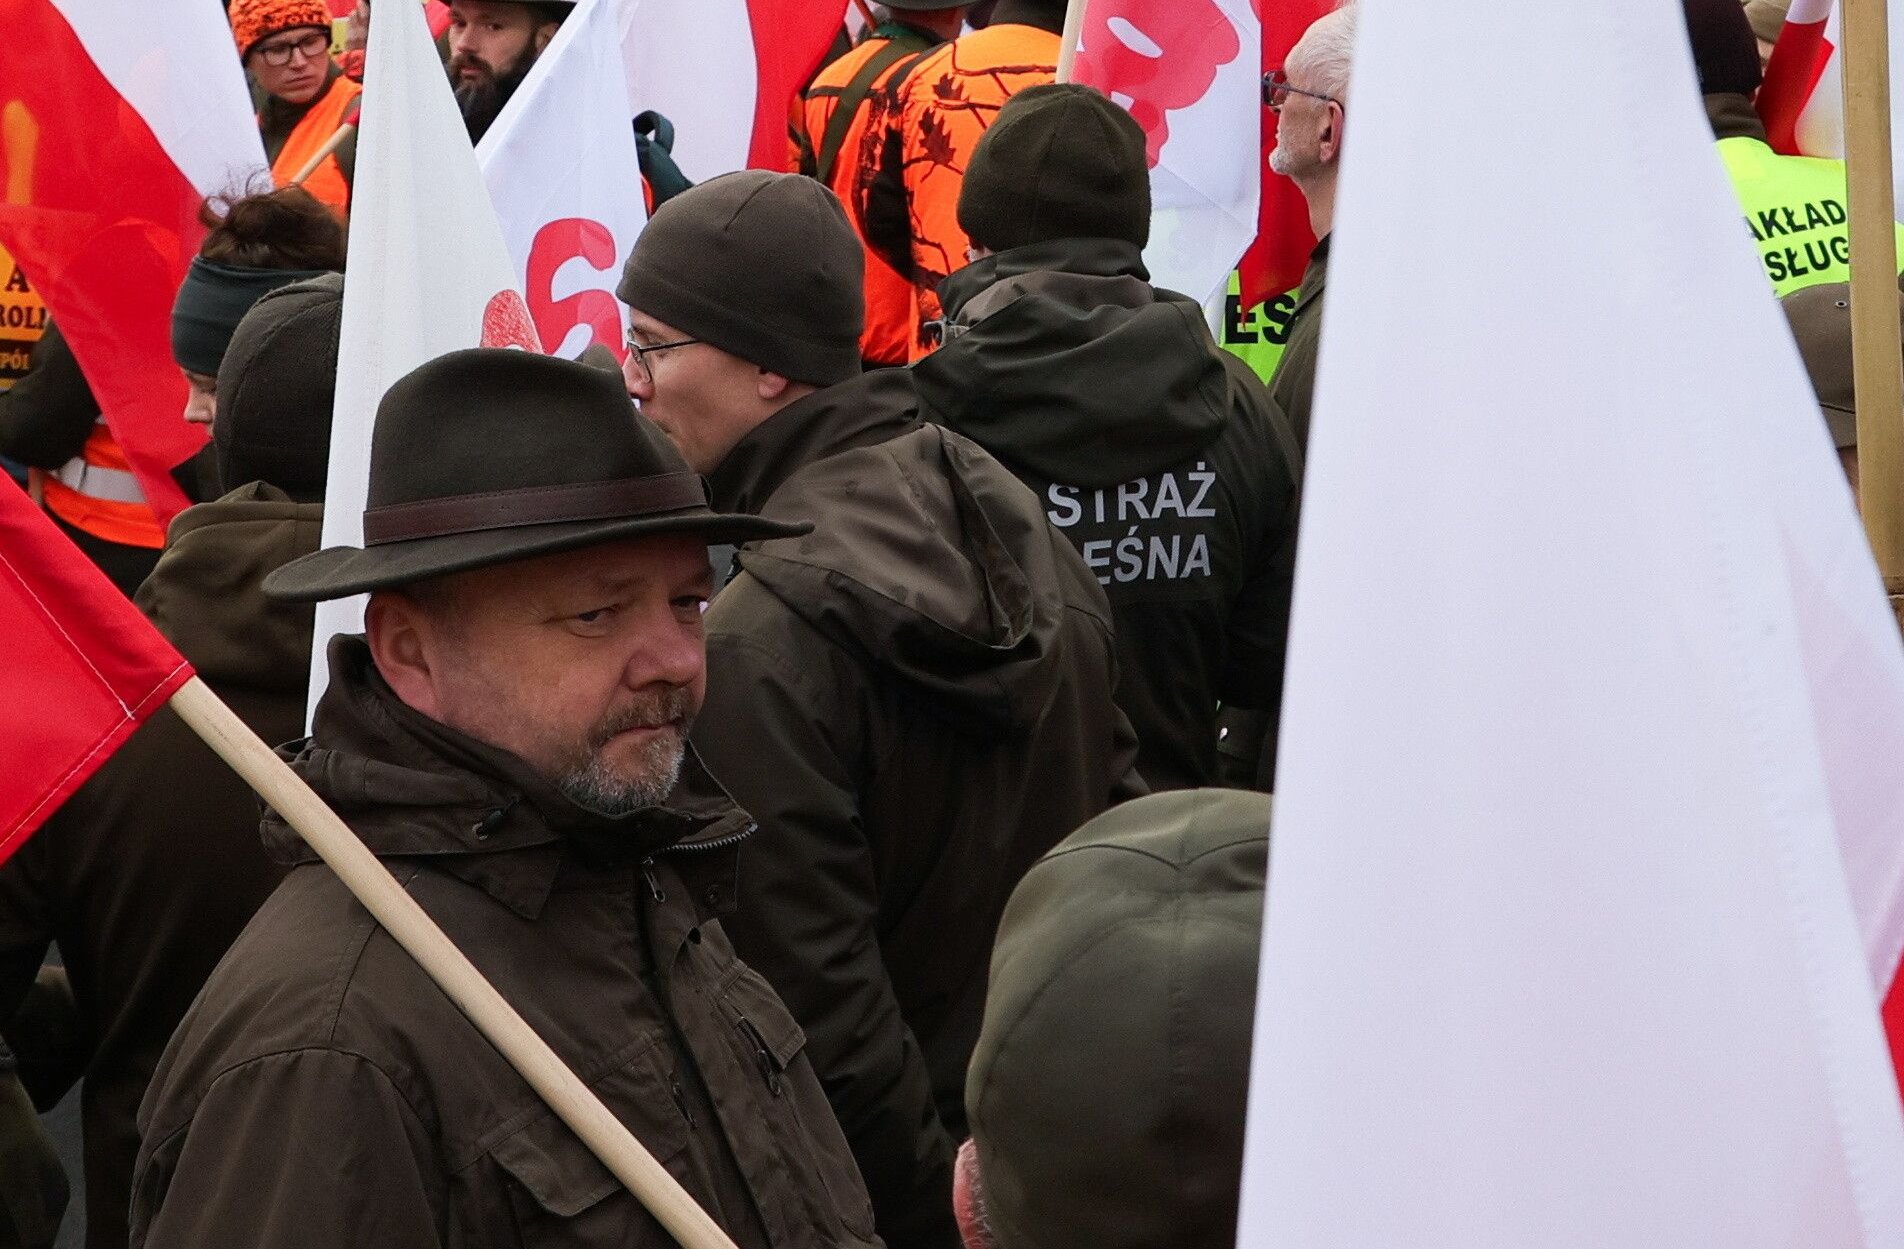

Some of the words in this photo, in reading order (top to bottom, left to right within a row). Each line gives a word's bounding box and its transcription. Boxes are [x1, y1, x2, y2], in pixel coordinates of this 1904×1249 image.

[1744, 199, 1847, 242] KŁAD
[1763, 236, 1850, 282] SŁUG
[1083, 525, 1212, 586] EŚNA
